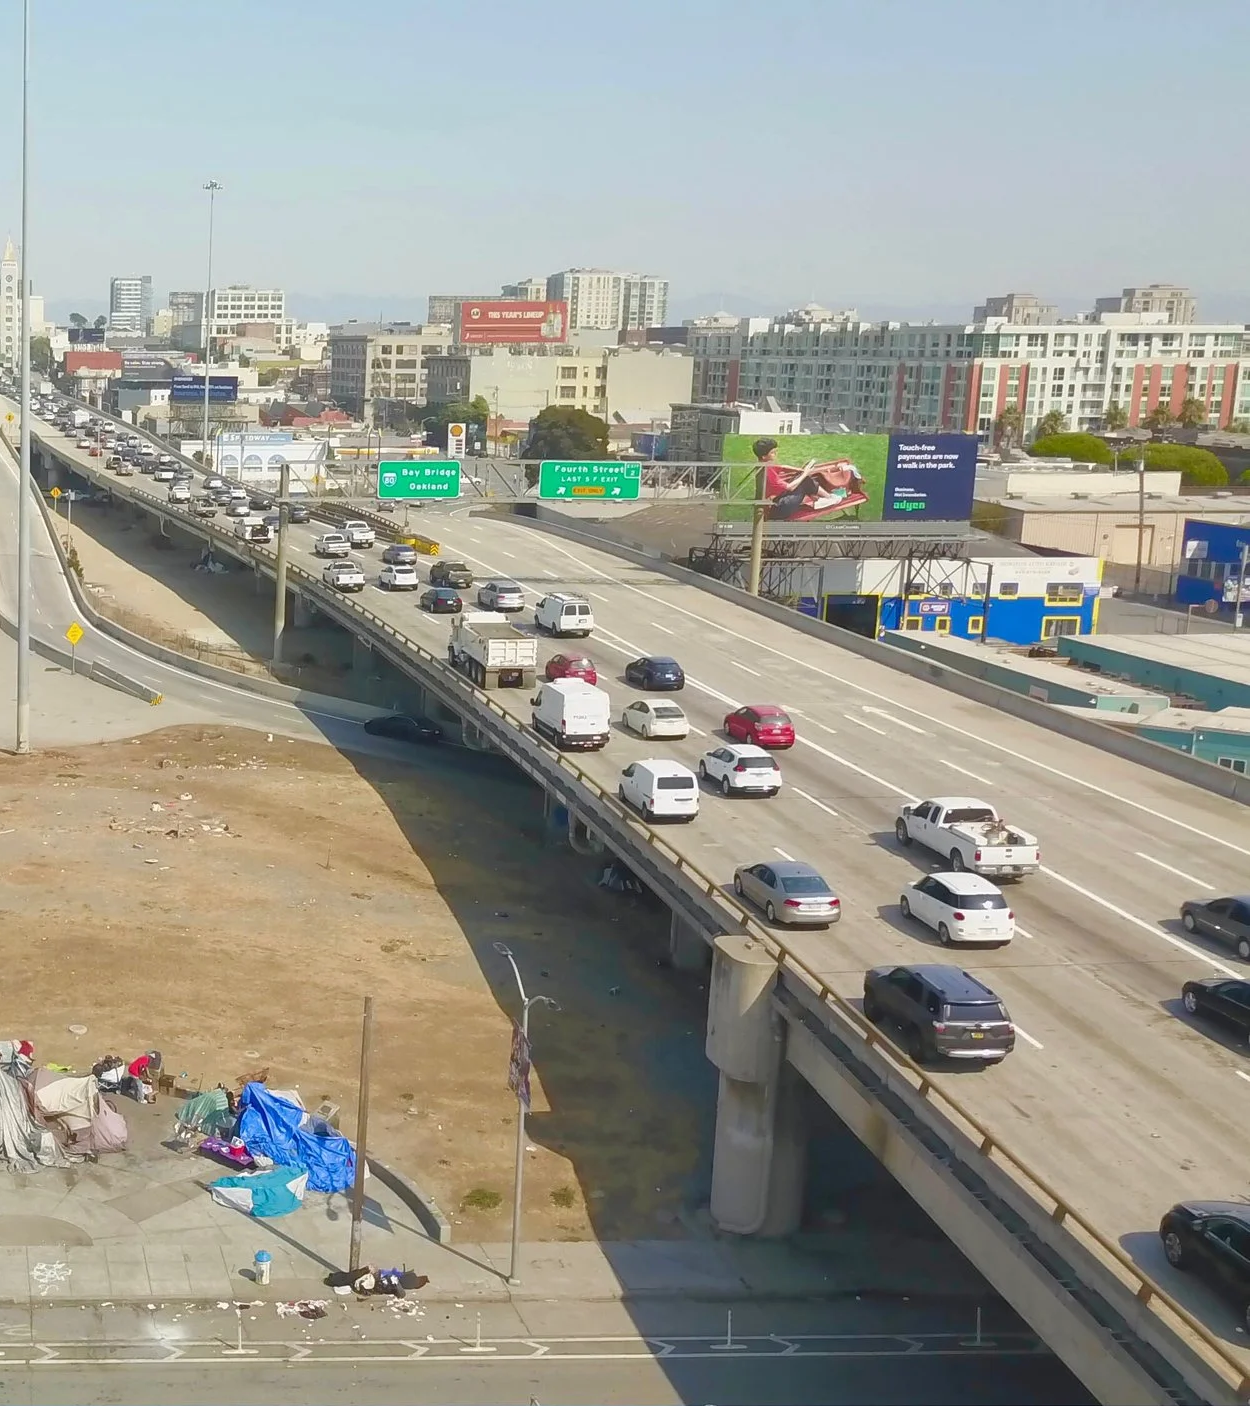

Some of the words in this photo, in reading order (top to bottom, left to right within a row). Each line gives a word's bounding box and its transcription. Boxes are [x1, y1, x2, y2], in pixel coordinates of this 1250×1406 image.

[897, 453, 931, 461] payments
[554, 465, 588, 473] Fourth
[592, 465, 625, 473] Street
[937, 462, 956, 470] park.
[402, 468, 420, 477] Bay
[424, 468, 457, 477] Bridge
[409, 482, 449, 490] Oakland
[893, 500, 926, 511] adyen
